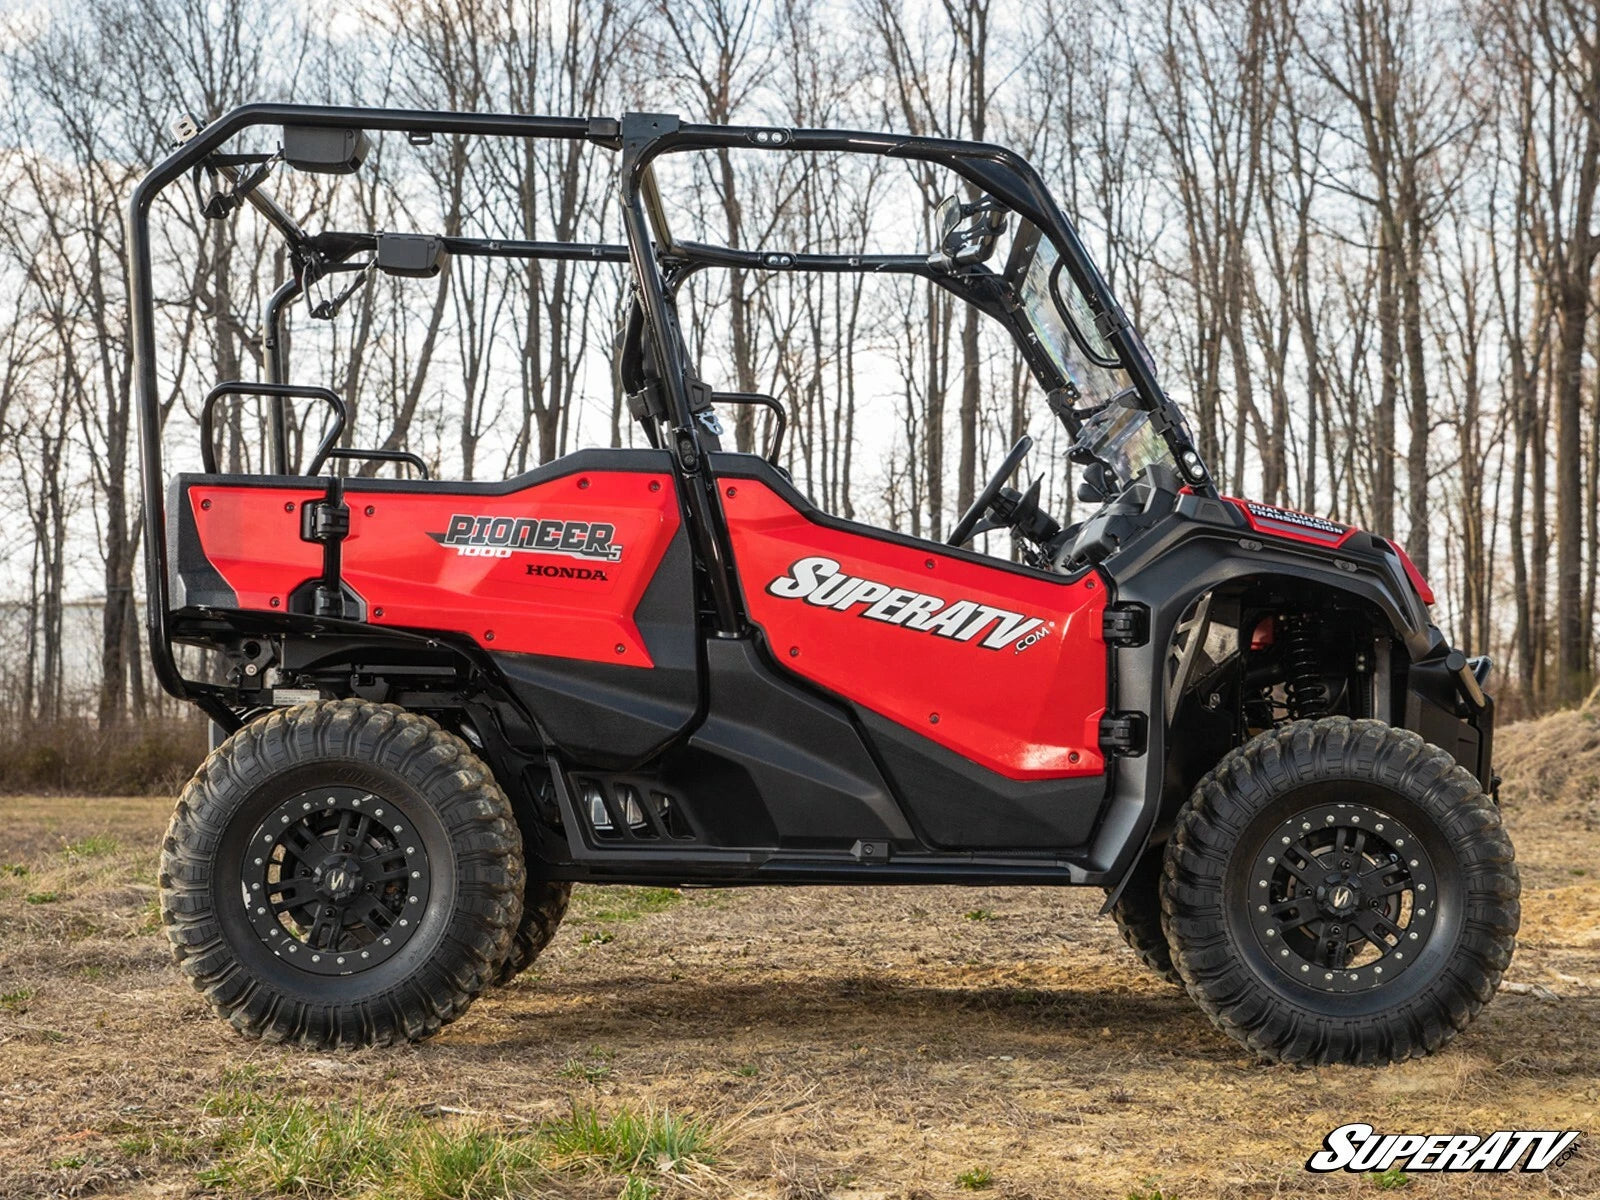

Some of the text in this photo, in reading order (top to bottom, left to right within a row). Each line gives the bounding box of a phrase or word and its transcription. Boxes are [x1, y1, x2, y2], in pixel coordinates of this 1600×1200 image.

[1247, 503, 1333, 527] DUAL CLUTCH
[1250, 509, 1344, 535] TRANSMISSION
[444, 513, 616, 553] PIONEER
[457, 546, 513, 559] 1000
[525, 564, 609, 582] HONDA
[765, 556, 1045, 651] SUPERATV
